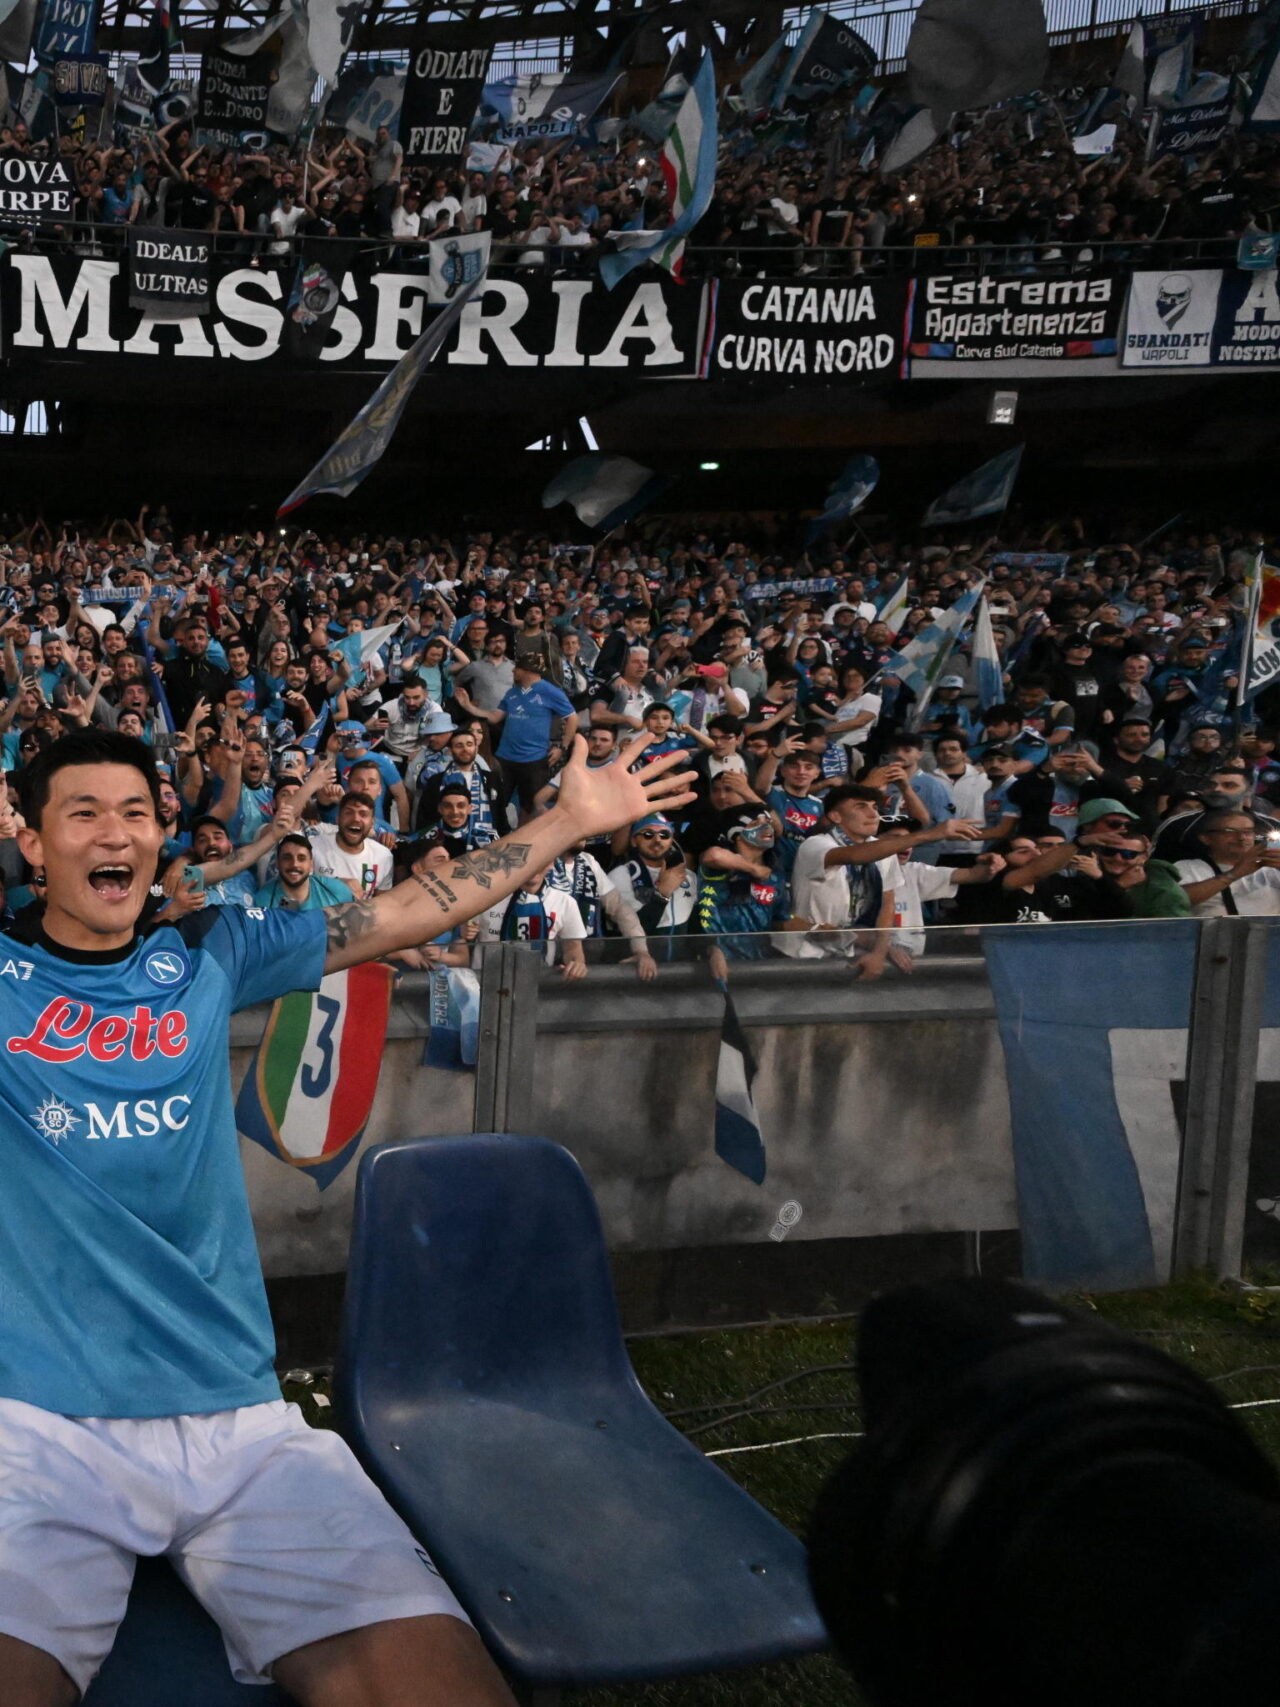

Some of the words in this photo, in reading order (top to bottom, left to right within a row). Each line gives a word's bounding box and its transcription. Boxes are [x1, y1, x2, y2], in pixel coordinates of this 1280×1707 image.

[416, 48, 488, 80] ODIATI
[206, 78, 268, 101] DURANTE
[436, 88, 455, 116] E
[407, 126, 467, 156] FIERI
[502, 122, 566, 140] NAPOLI
[135, 240, 208, 263] IDEALE
[134, 272, 208, 295] ULTRAS
[926, 275, 1113, 305] Estrema
[740, 285, 877, 324] CATANIA
[924, 307, 1108, 342] Appartenenza
[1231, 325, 1280, 341] MODO
[955, 344, 991, 359] Curva
[994, 343, 1019, 359] Sud
[1020, 343, 1065, 357] Catania
[1127, 332, 1211, 349] SBANDATI
[717, 333, 807, 375] CURVA
[814, 333, 895, 375] NORD
[1141, 349, 1191, 361] NAPOLI
[753, 888, 776, 902] ete
[148, 955, 180, 980] N
[6, 995, 189, 1064] Lete
[300, 994, 341, 1098] 3
[83, 1093, 193, 1140] MSC
